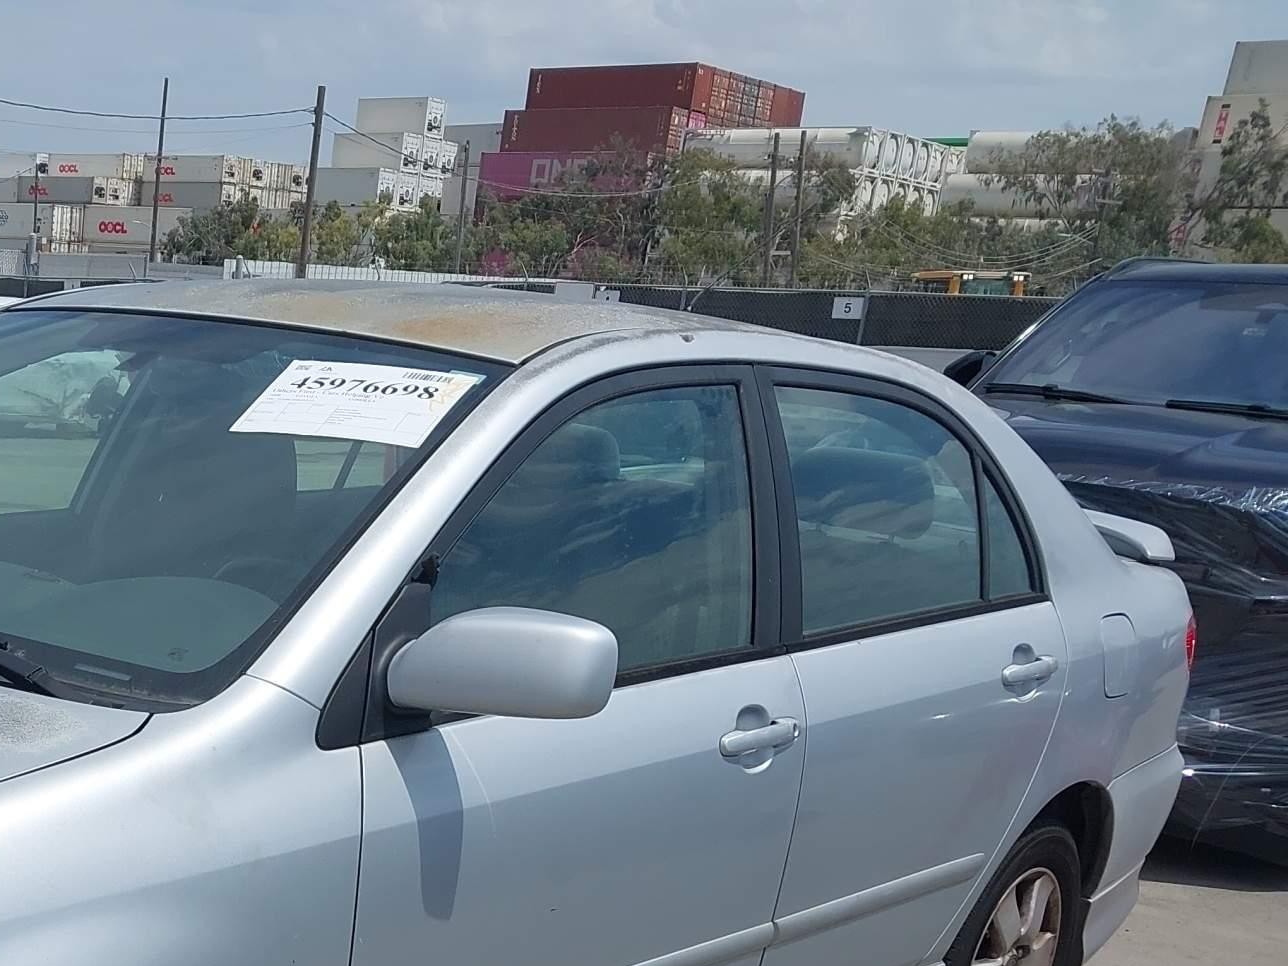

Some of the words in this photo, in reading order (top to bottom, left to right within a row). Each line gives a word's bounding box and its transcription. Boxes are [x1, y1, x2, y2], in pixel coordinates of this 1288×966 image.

[58, 164, 78, 173] OOCL
[156, 167, 175, 175] OCL
[98, 221, 127, 234] OOCL
[843, 302, 853, 314] 5
[290, 375, 439, 400] 45976698
